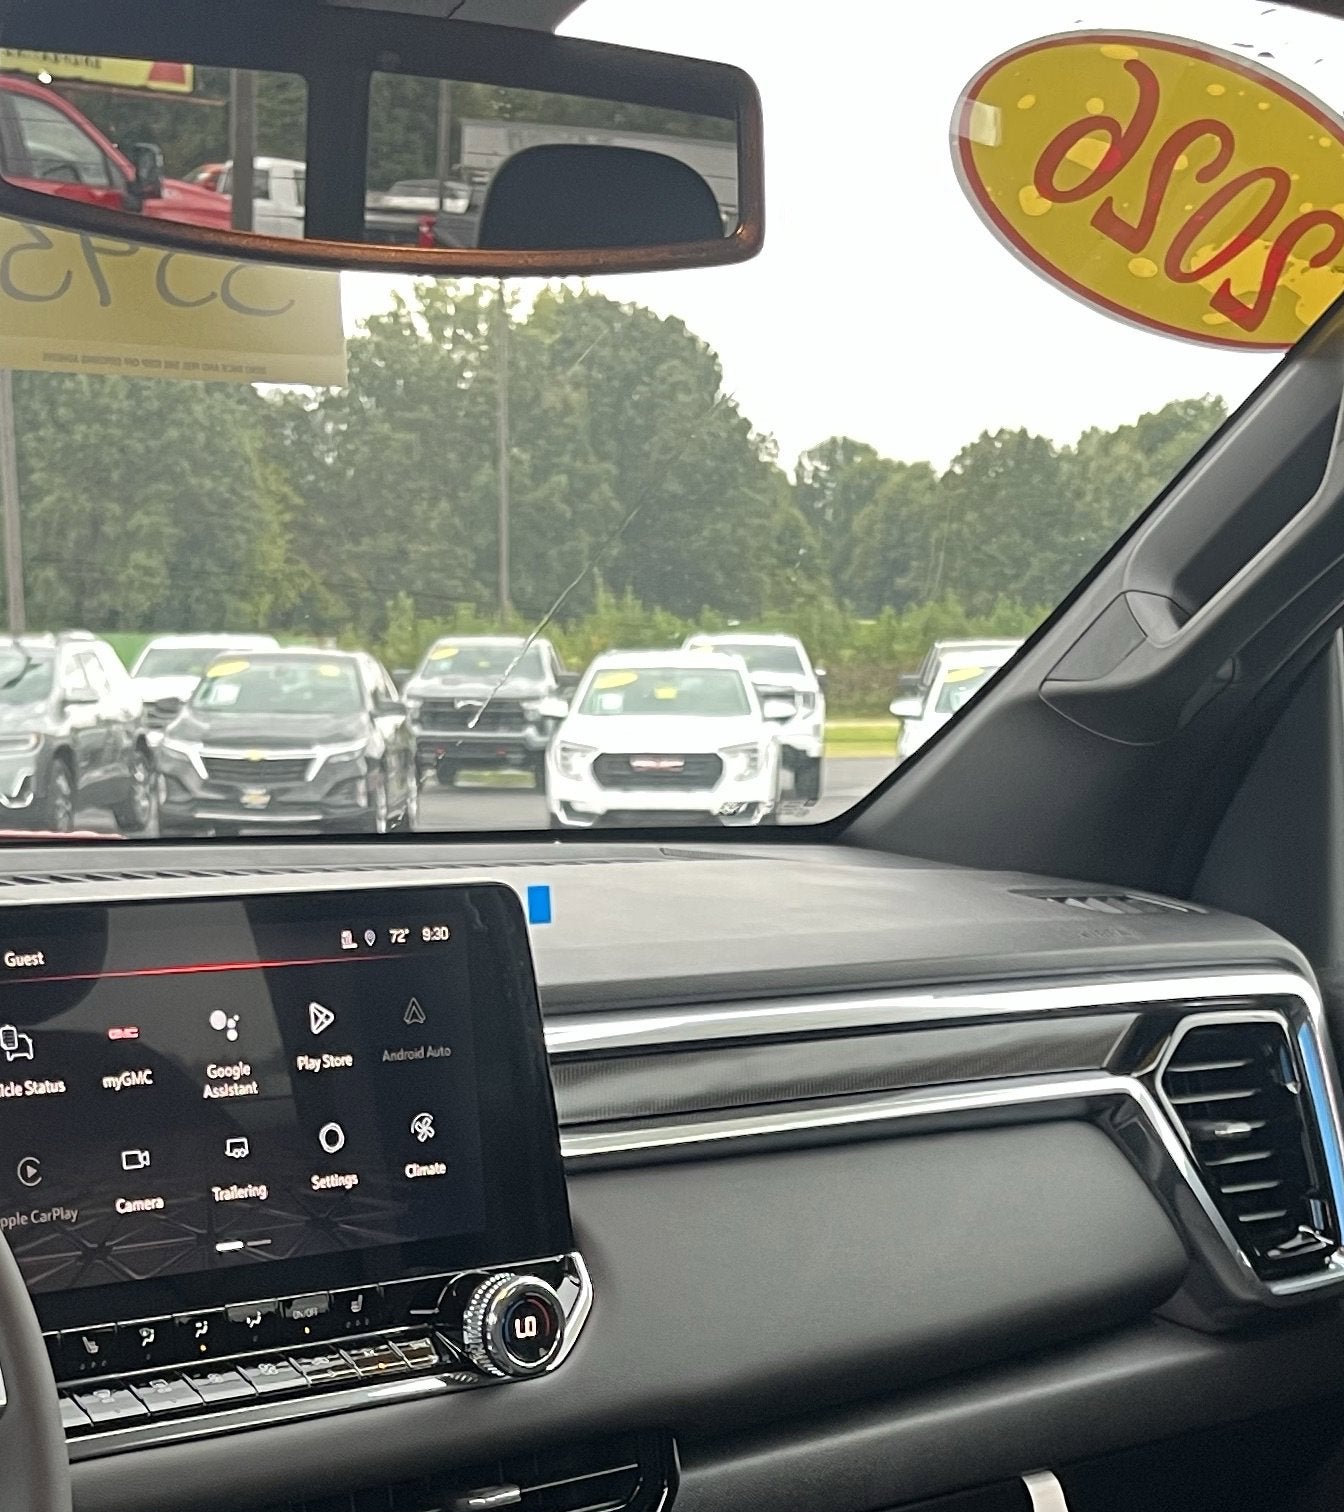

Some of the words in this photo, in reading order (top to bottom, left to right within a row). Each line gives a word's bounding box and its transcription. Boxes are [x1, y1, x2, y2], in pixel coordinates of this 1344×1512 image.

[422, 926, 450, 942] 9:30
[5, 950, 45, 968] Guest
[383, 1045, 425, 1062] Android
[425, 1045, 452, 1058] Auto
[206, 1060, 252, 1081] Google
[296, 1055, 321, 1073] Play
[322, 1053, 354, 1069] Store
[24, 1079, 67, 1097] Status
[102, 1068, 154, 1091] myGMC
[203, 1080, 259, 1099] Assistant
[404, 1161, 447, 1179] Climate
[311, 1173, 359, 1191] Settings
[212, 1184, 269, 1202] Trailering
[115, 1195, 165, 1214] Camera
[0, 1211, 28, 1230] pple
[30, 1206, 79, 1224] CarPlay
